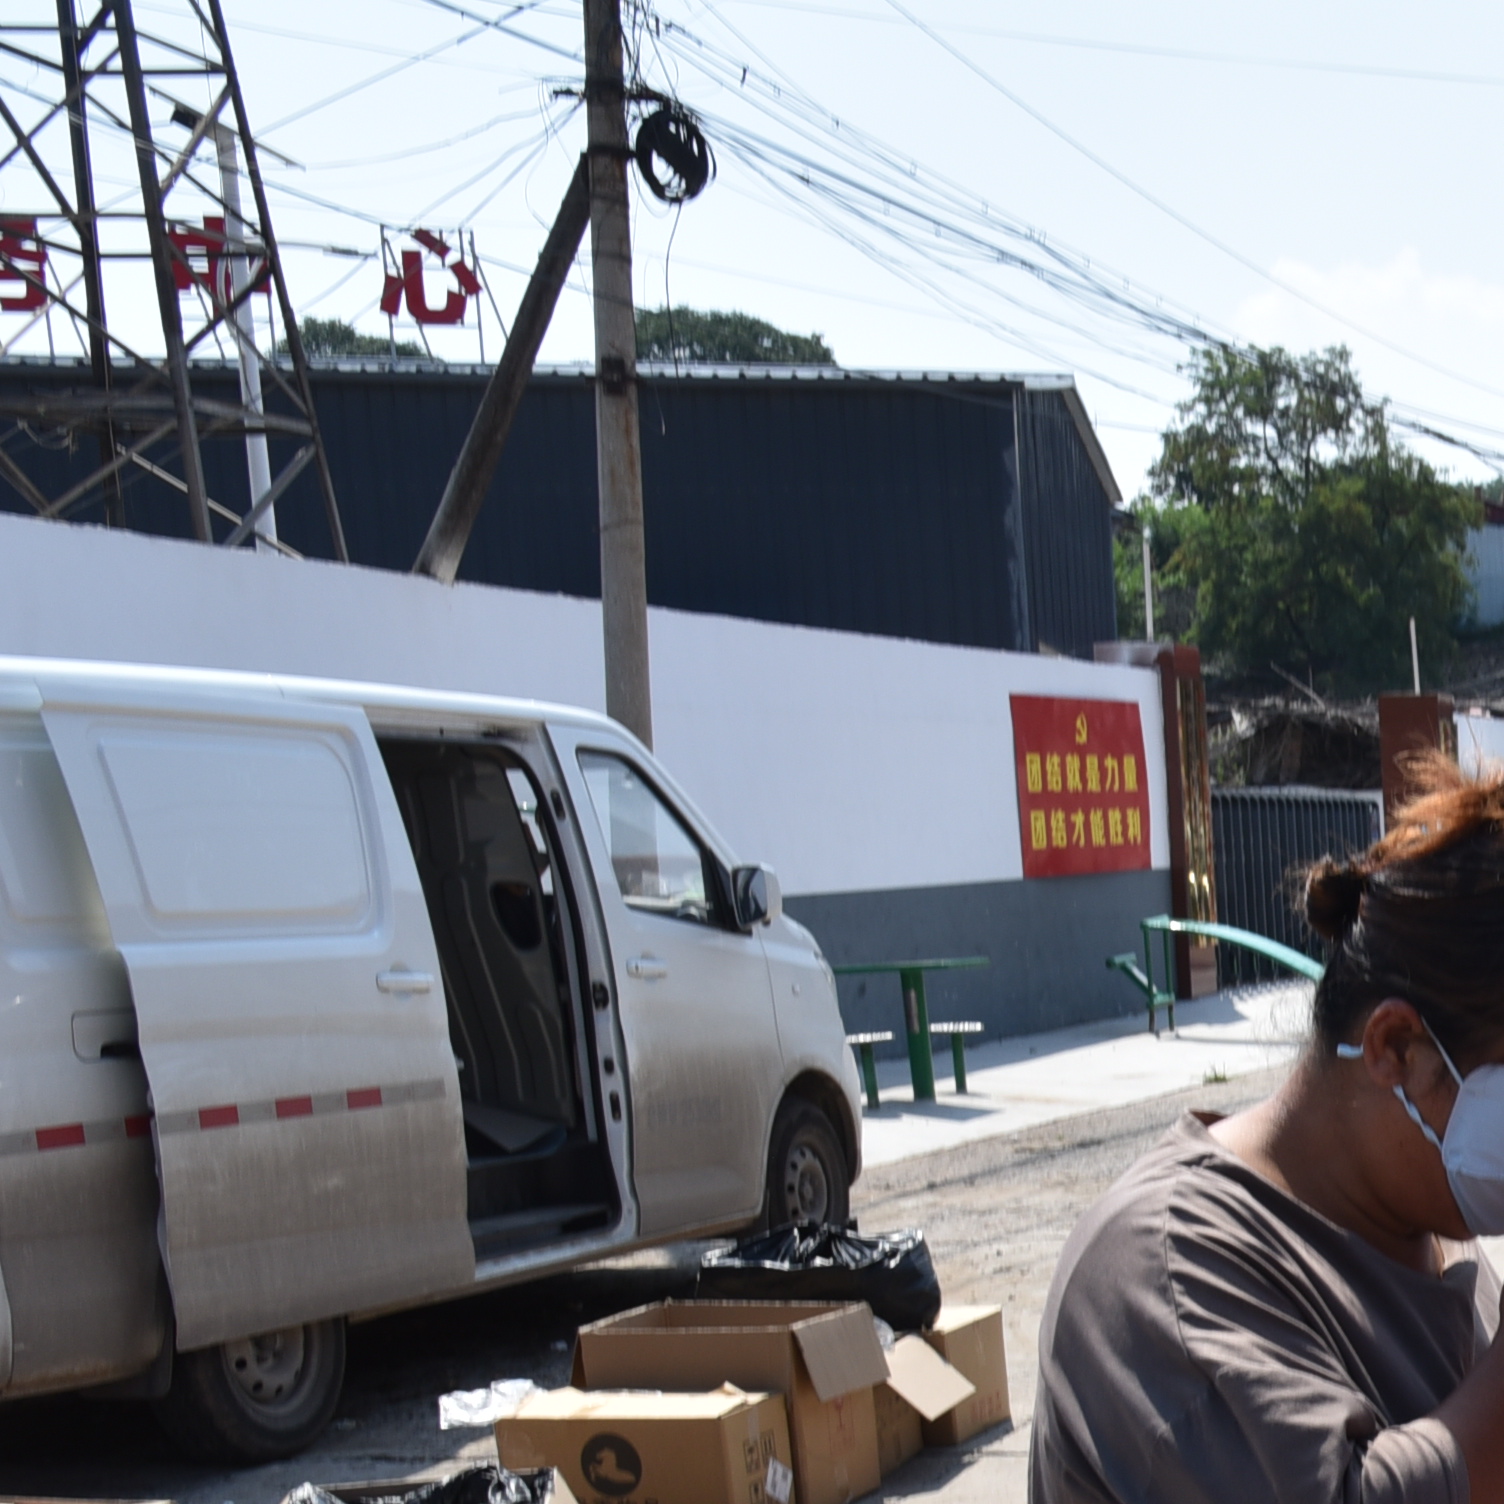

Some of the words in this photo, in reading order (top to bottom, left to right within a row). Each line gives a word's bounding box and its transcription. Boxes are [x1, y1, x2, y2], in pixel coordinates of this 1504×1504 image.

[1025, 752, 1139, 795] 团结就是力量
[1029, 807, 1142, 851] 团结才能胜利
